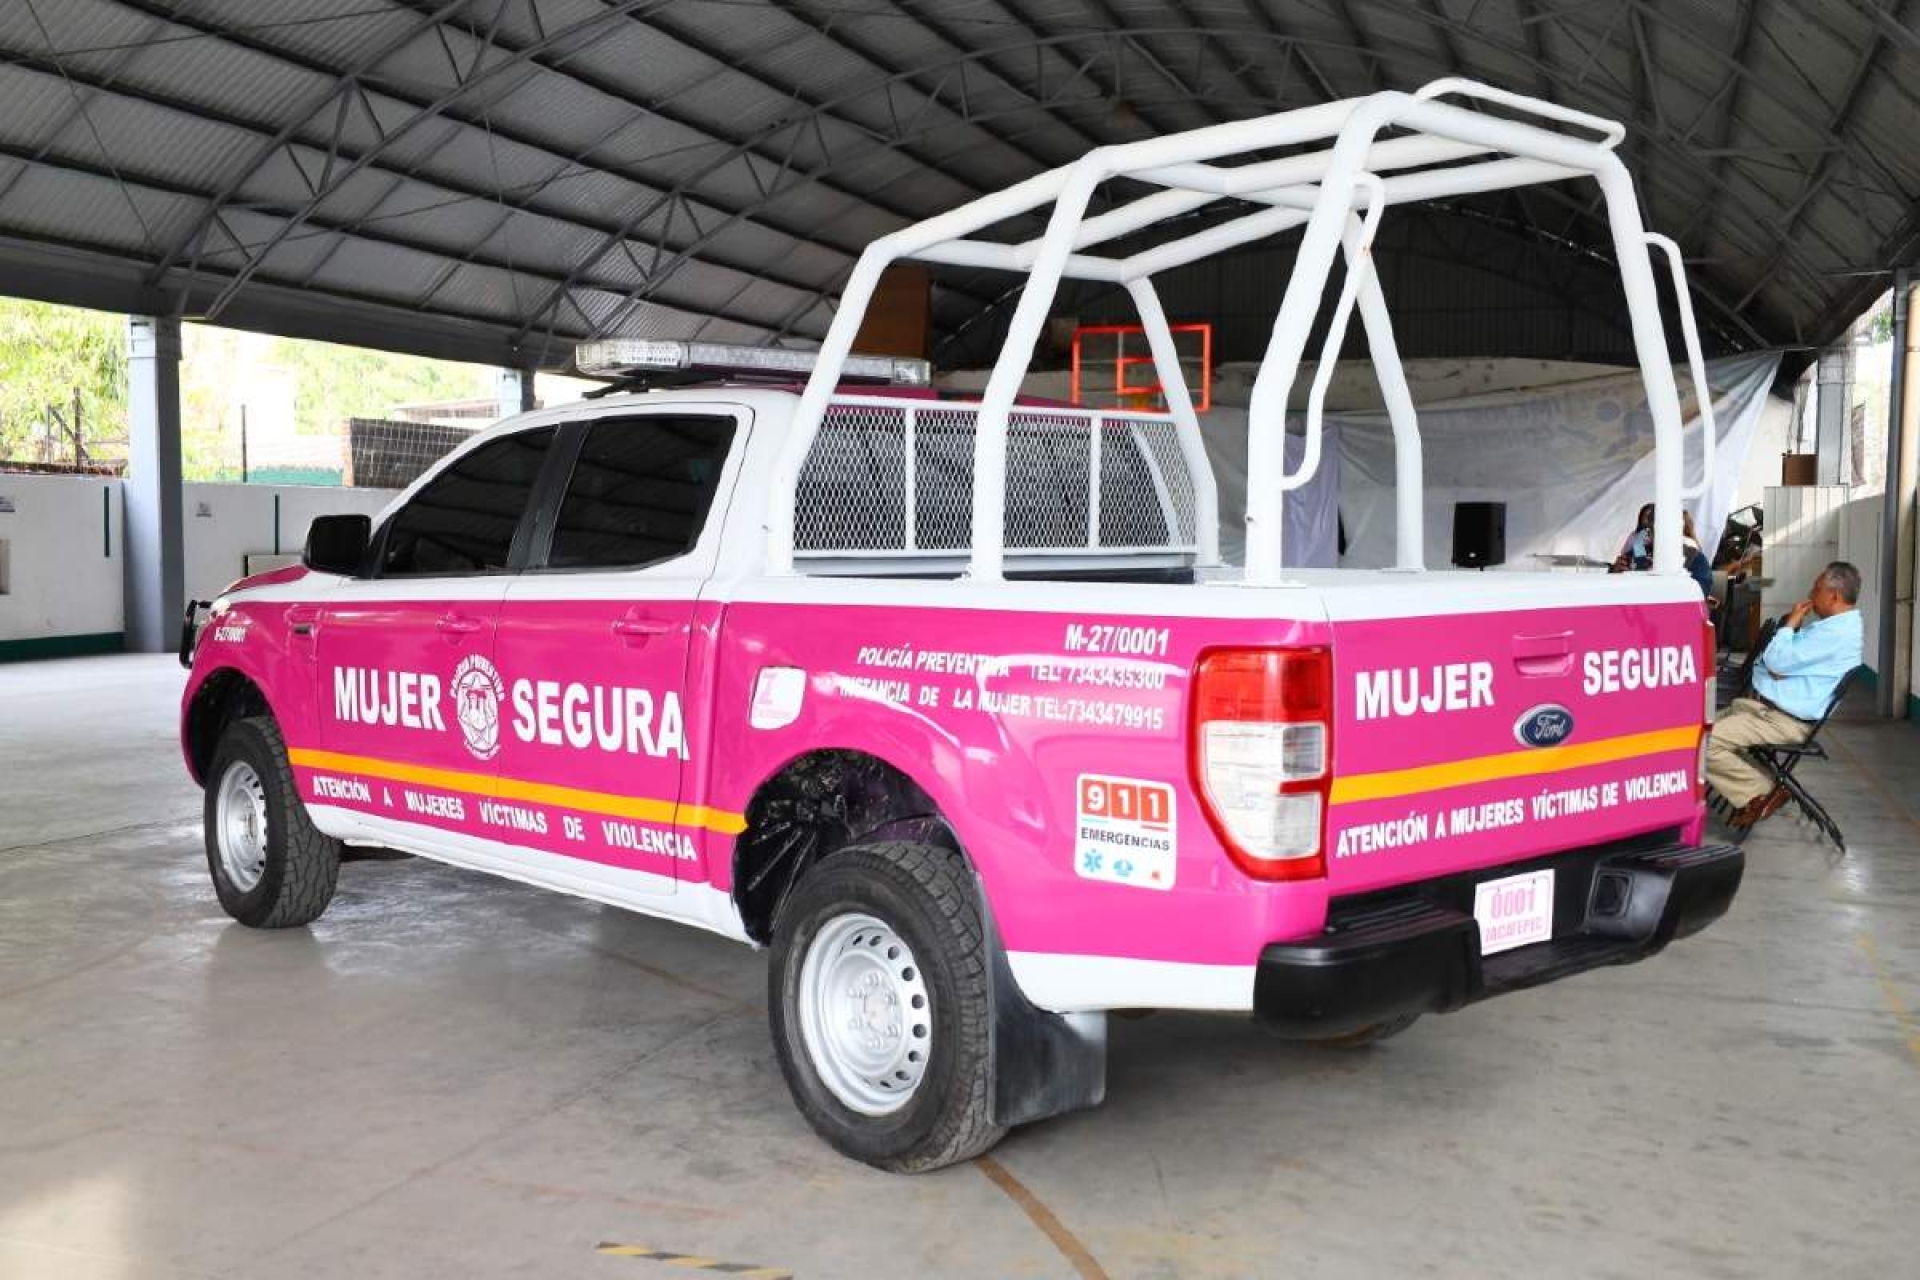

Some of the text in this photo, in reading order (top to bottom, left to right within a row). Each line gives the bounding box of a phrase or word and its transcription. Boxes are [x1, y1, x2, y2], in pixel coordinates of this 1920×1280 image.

[1065, 624, 1169, 657] M-27/0001
[857, 643, 912, 669] POLICÍA
[1066, 662, 1166, 691] 7343435300
[1356, 645, 1697, 720] MUJER SEGURA
[334, 666, 690, 761] MUJER SEGURA
[918, 685, 940, 707] DE
[952, 688, 973, 711] LA
[978, 690, 1031, 718] MUJER
[1534, 713, 1566, 740] Ford
[313, 776, 697, 861] ATENCIÓN A MUJERES VÍCTIMAS DE VIOLENCIA
[1087, 784, 1160, 820] 911
[1336, 769, 1688, 858] ATENCIÓN A MUJERES VÍCTIMAS DE VIOLENCIA
[1081, 826, 1171, 852] EMERGENCIAS
[1491, 887, 1537, 919] 0001
